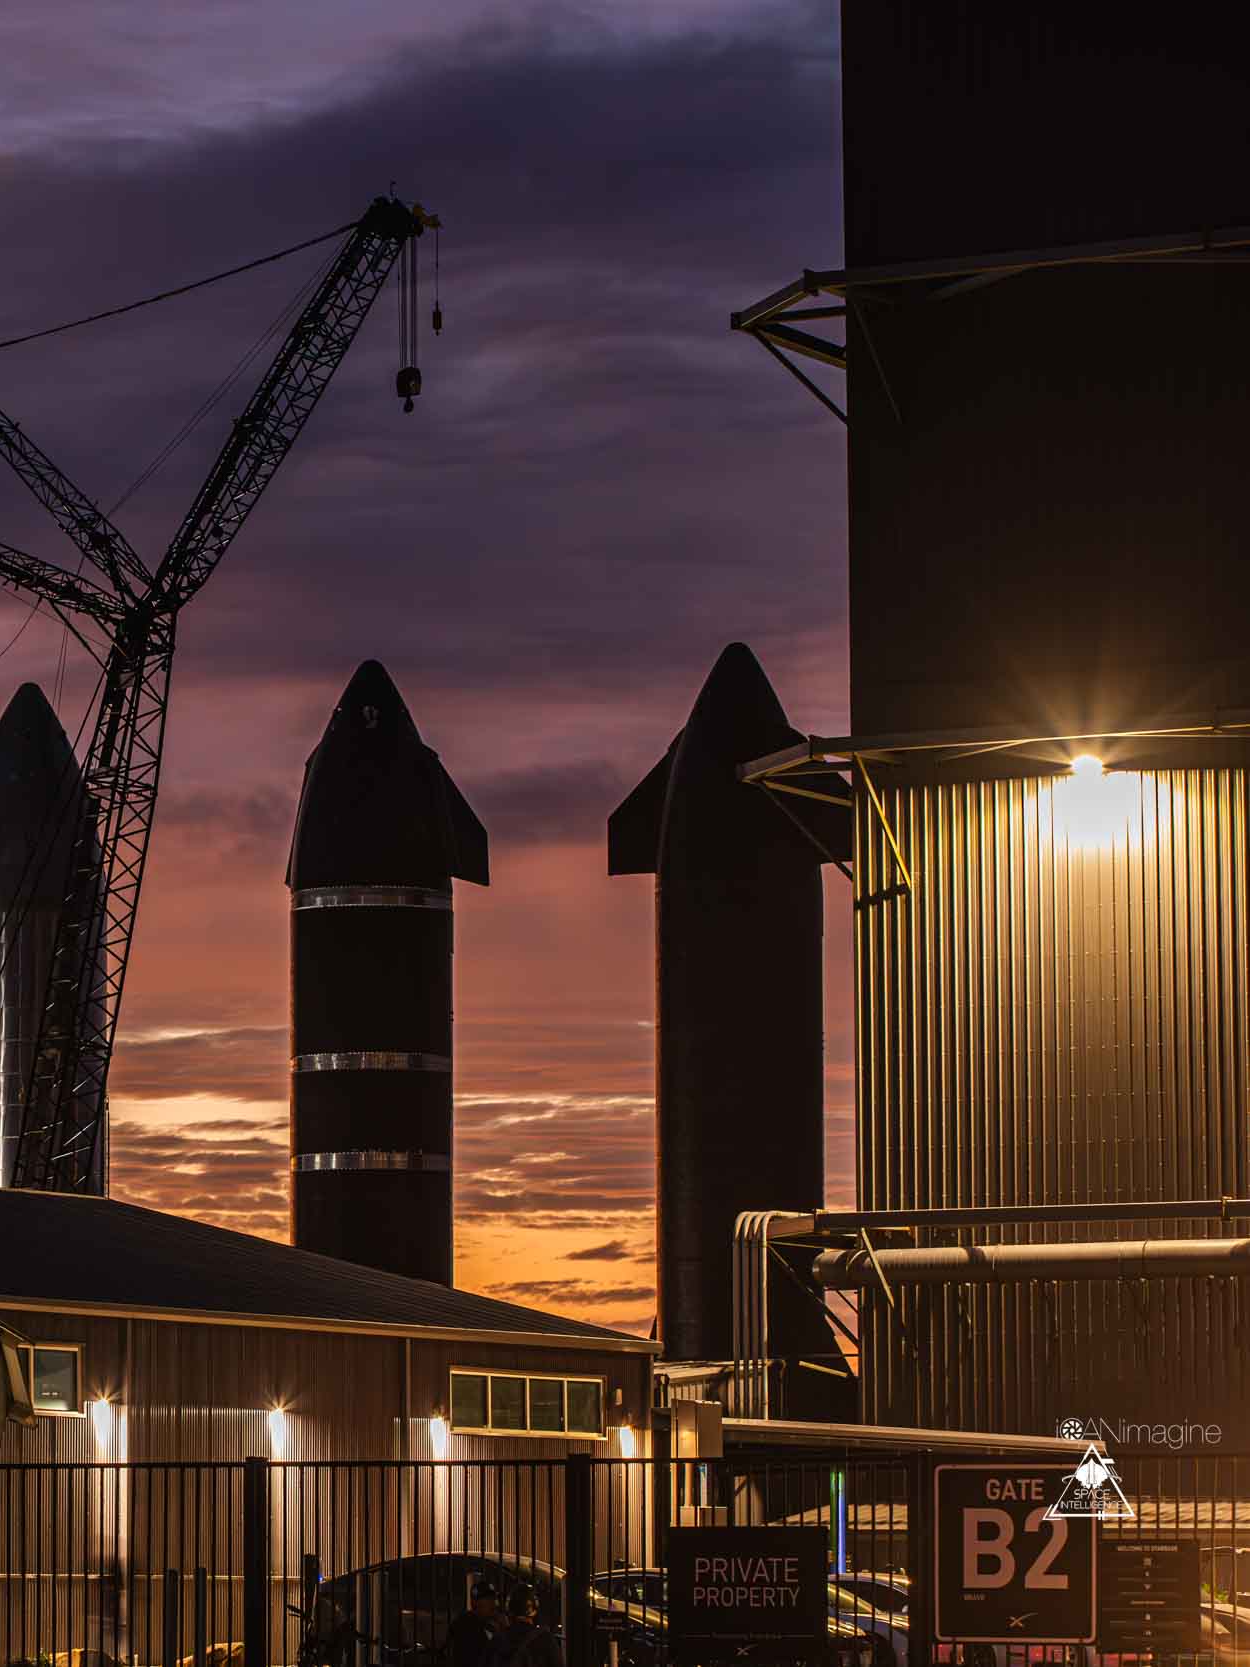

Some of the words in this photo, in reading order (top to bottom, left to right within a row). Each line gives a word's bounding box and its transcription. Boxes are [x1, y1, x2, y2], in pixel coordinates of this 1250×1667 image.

[985, 1478, 1045, 1501] GATE
[962, 1506, 1070, 1590] B2
[694, 1557, 799, 1583] PRIVATE
[693, 1586, 800, 1608] PROPERTY
